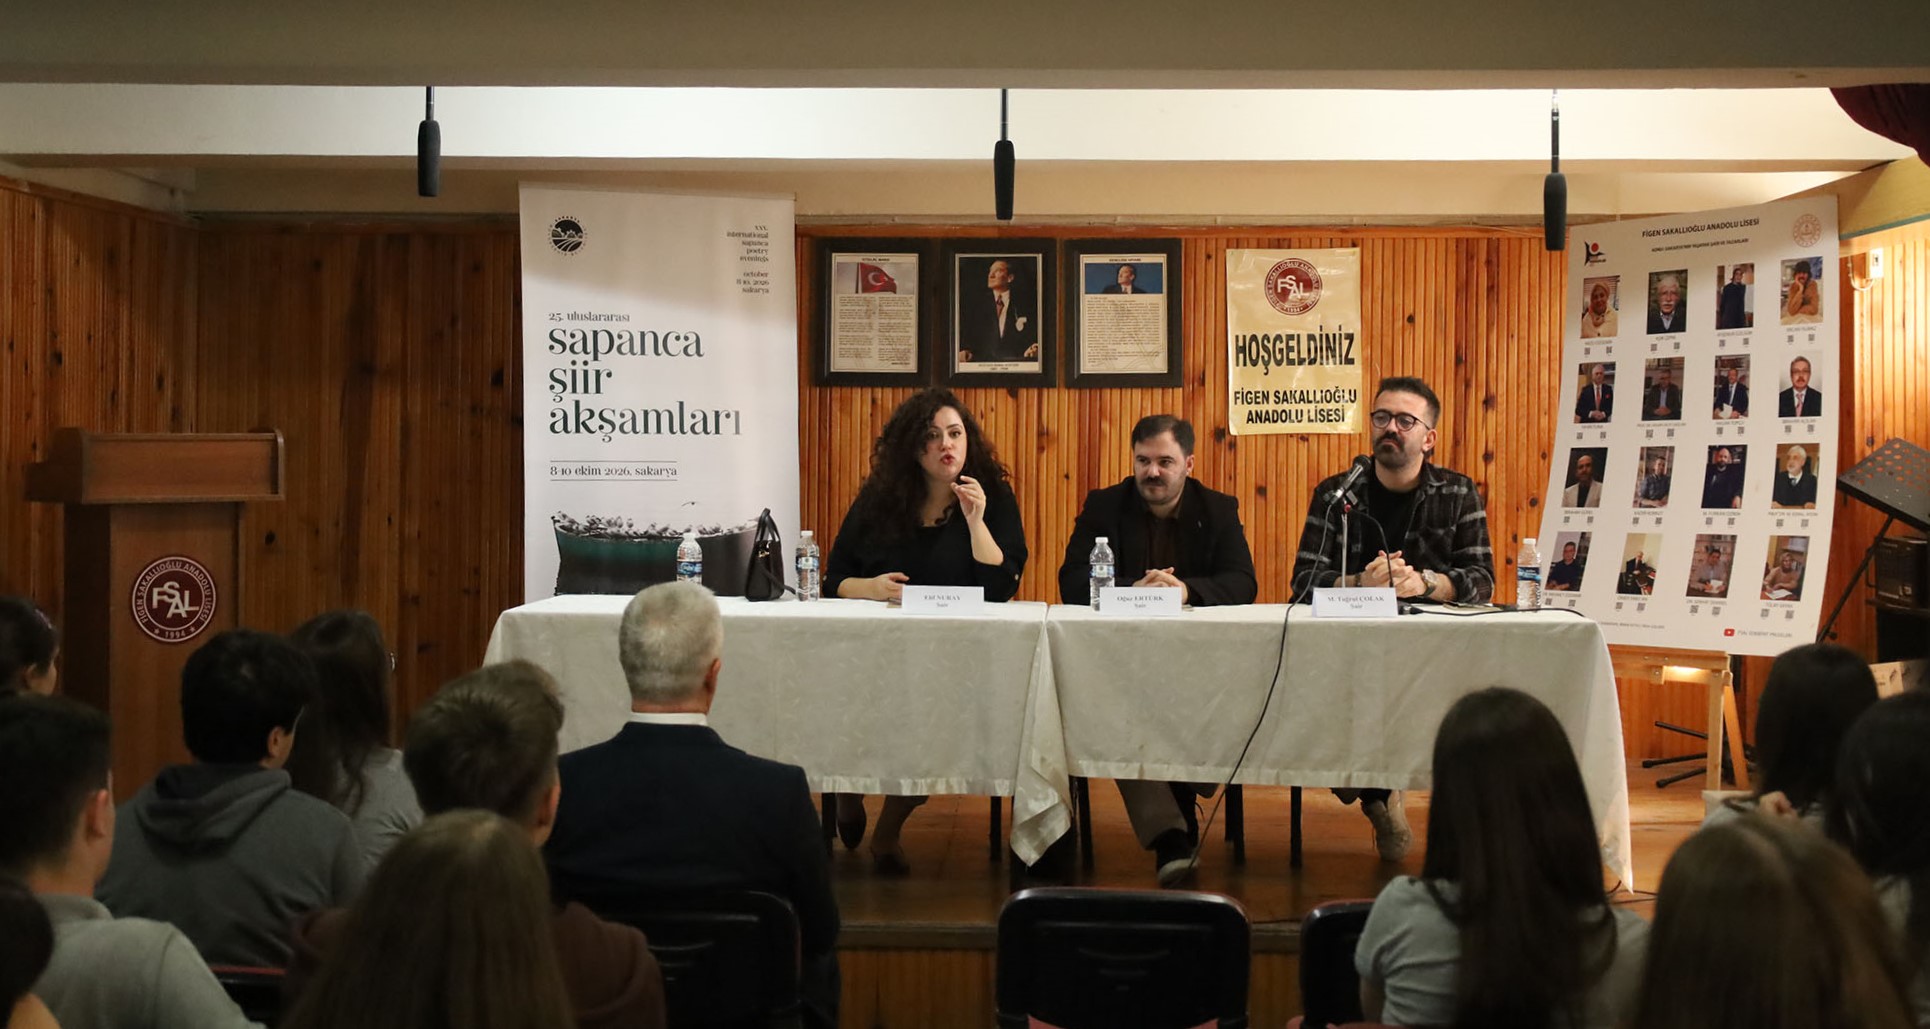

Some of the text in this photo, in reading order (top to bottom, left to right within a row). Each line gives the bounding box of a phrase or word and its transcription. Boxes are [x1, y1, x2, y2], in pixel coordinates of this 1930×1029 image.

[1642, 217, 1760, 238] FİGEN SAKALLIOĞLU ANADOLU LİSESİ
[548, 310, 631, 323] 25. uluslararası
[548, 327, 705, 361] sapanca
[1234, 324, 1356, 375] HOŞGELDİNİZ
[548, 360, 613, 403] şiir
[1234, 386, 1357, 406] FİGEN SAKALLIOĞLU
[549, 400, 743, 443] akşamları
[1246, 405, 1345, 425] ANADOLU LİSESİ
[574, 465, 602, 476] ekim
[604, 466, 632, 477] 2026,
[635, 465, 677, 478] sakarya
[138, 560, 183, 596] SAKALLIOĞLU
[183, 562, 212, 596] ANADOLU
[152, 581, 200, 619] FSAL
[165, 630, 186, 639] 1994
